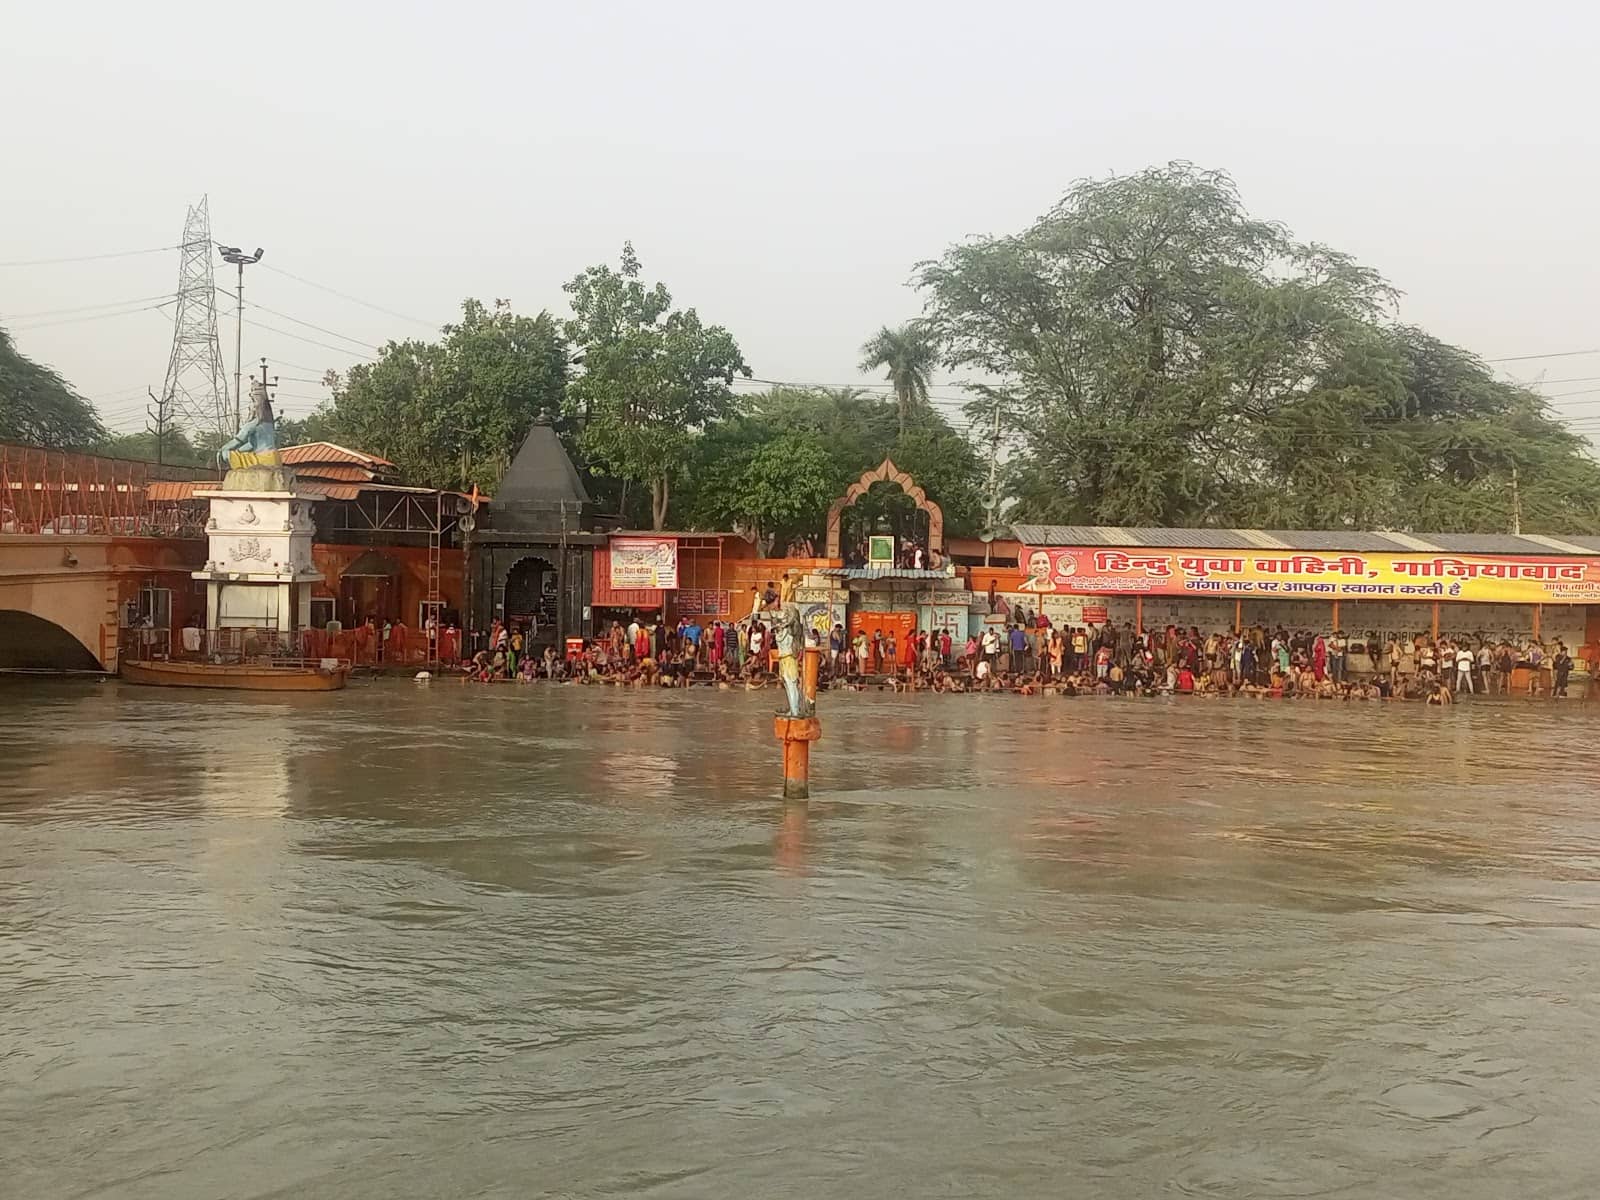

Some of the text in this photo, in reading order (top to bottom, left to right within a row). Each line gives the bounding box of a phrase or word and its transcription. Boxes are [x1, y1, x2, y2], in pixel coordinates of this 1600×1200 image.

[1095, 552, 1587, 580] हिन्दु युवा वाहिनी, गाज़ियाबाद
[1186, 578, 1460, 596] गंगा घाट पर आपका स्वागत करती है
